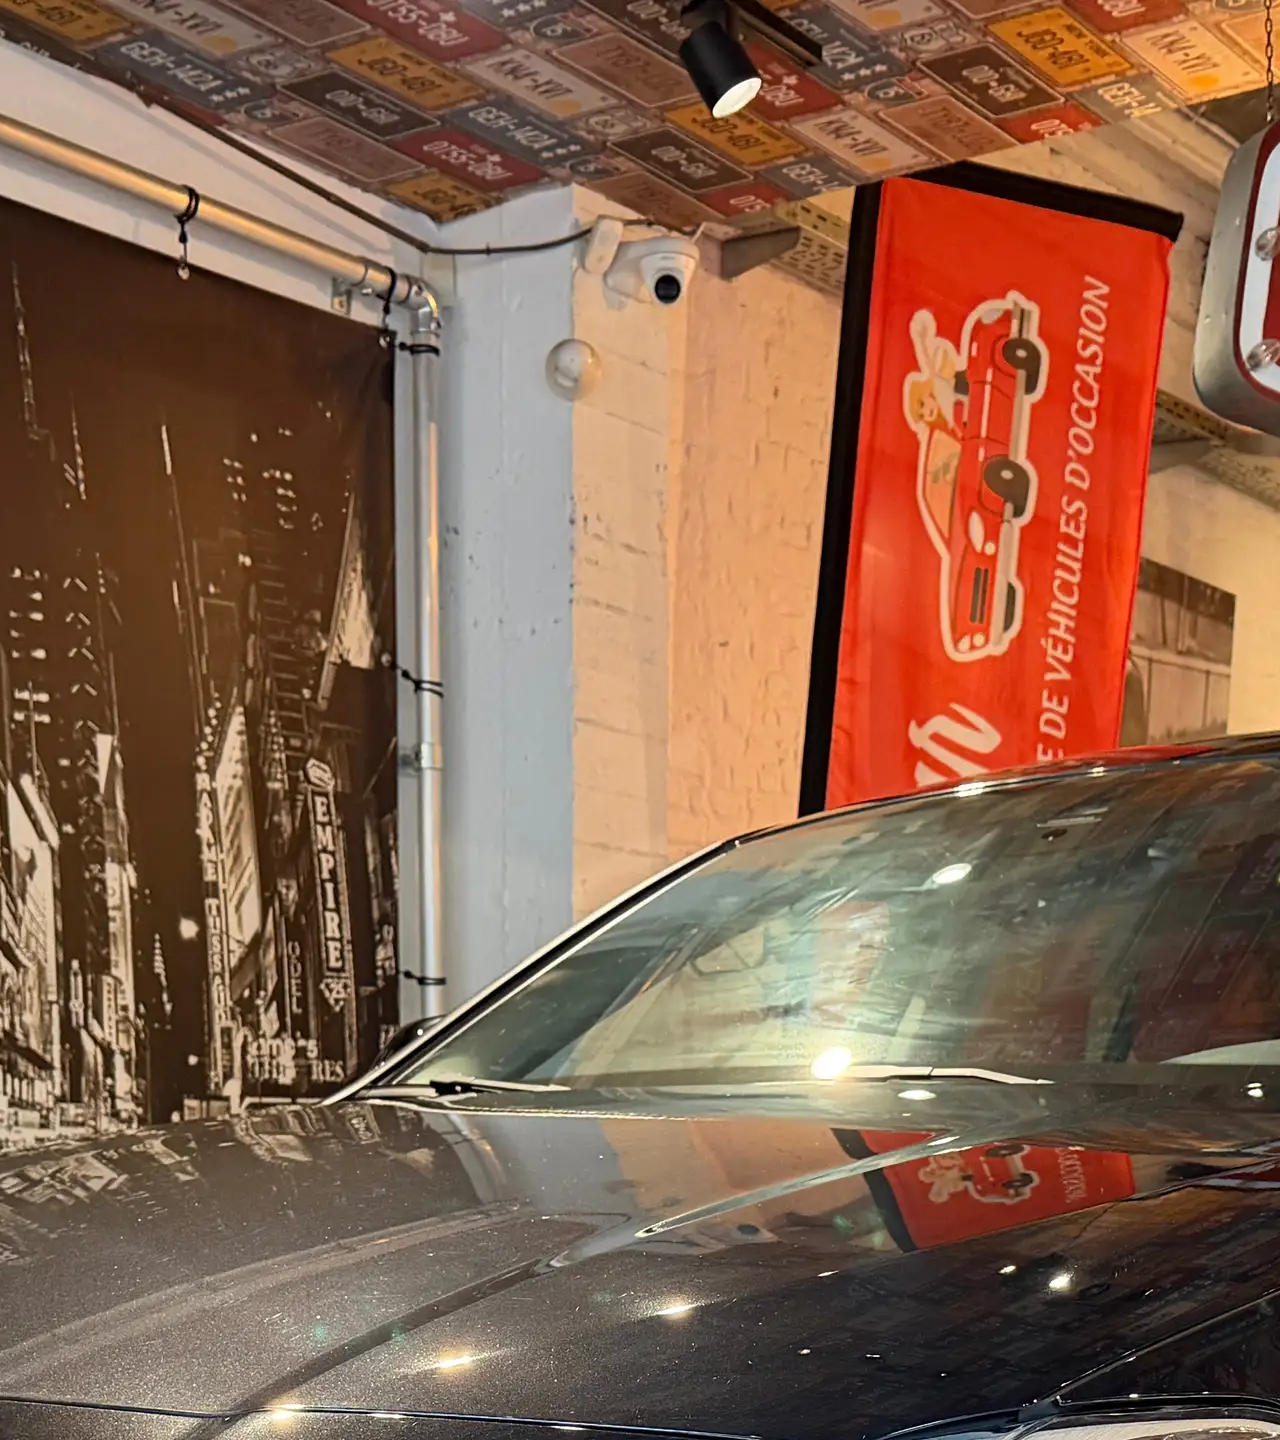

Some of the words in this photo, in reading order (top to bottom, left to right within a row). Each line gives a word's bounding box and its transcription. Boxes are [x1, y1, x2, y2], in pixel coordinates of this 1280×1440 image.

[1041, 495, 1088, 682] VÉHICULES
[1038, 689, 1069, 741] DE
[313, 796, 344, 971] EMPIRE
